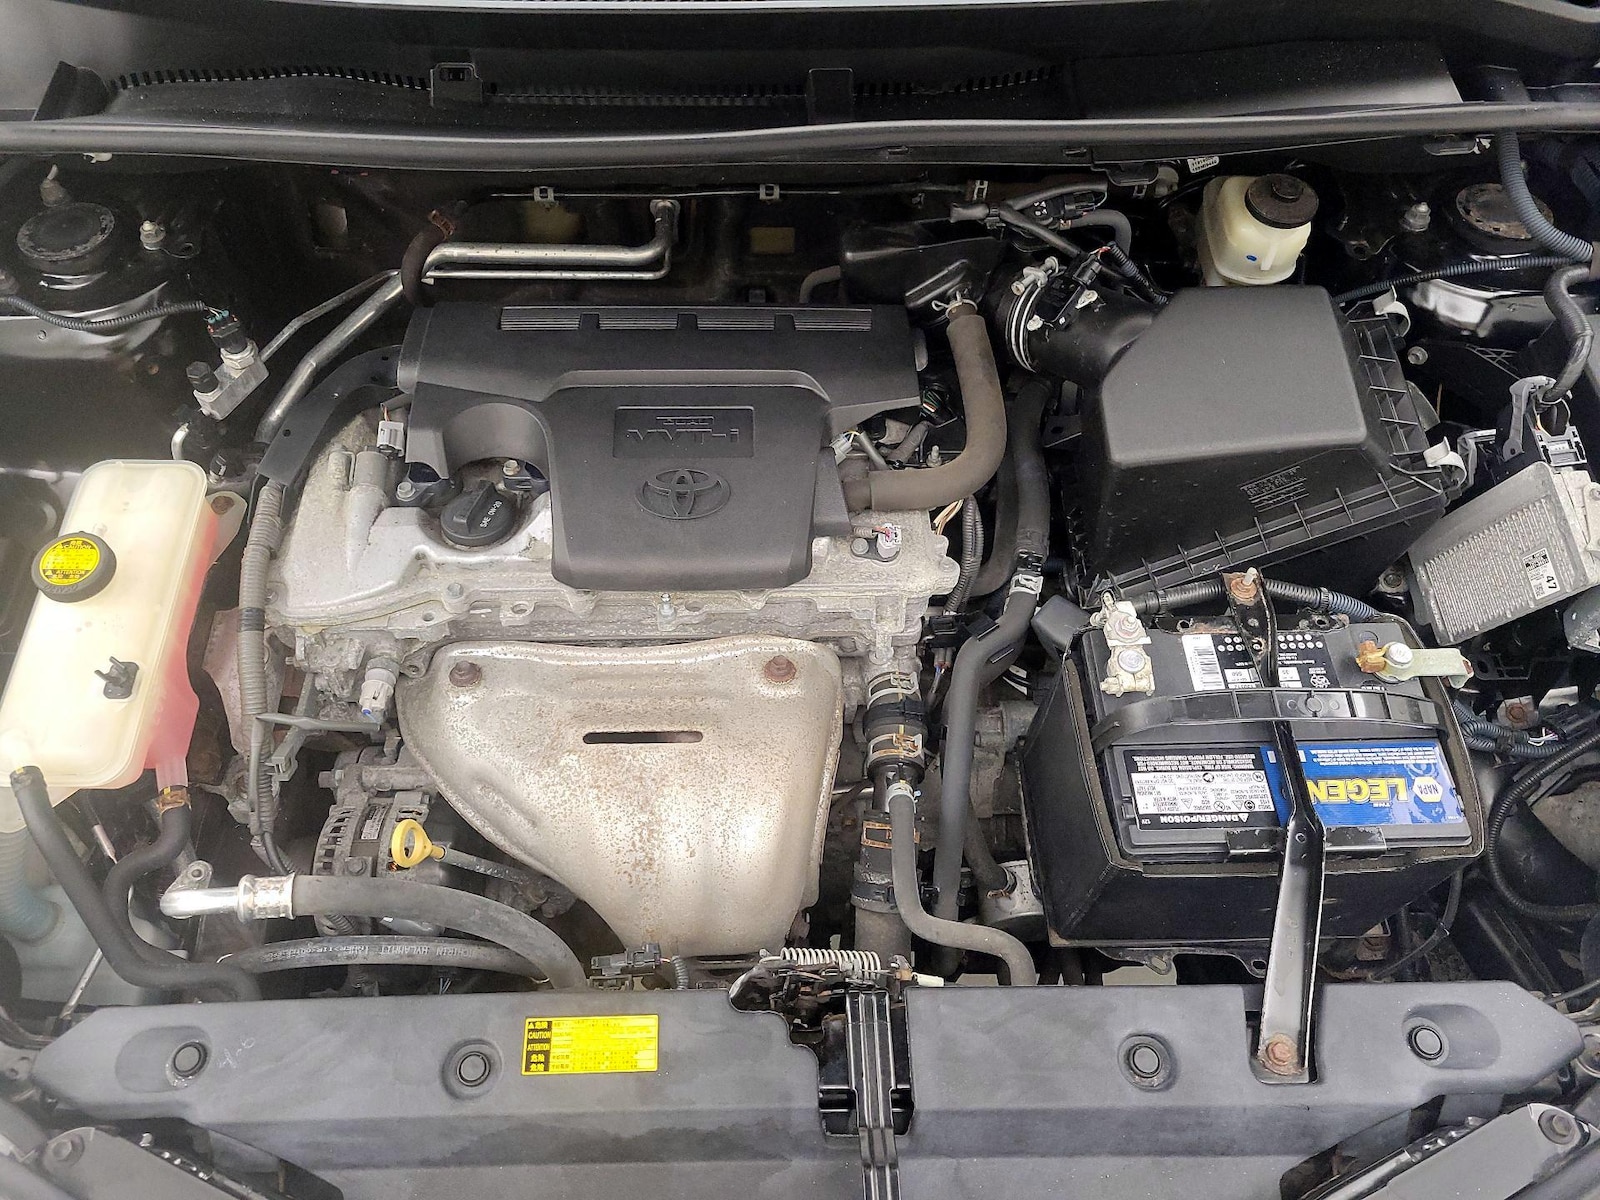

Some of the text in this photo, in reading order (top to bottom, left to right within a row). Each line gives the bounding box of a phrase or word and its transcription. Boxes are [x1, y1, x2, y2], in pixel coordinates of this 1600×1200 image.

[479, 500, 503, 528] SAE 0W-20
[1546, 575, 1557, 589] 47
[1305, 777, 1409, 804] LEGEN
[1417, 783, 1439, 795] NAPA
[1159, 814, 1239, 823] DANGER/POISON
[528, 1031, 552, 1040] CAUTION
[526, 1042, 551, 1051] ATTENTION
